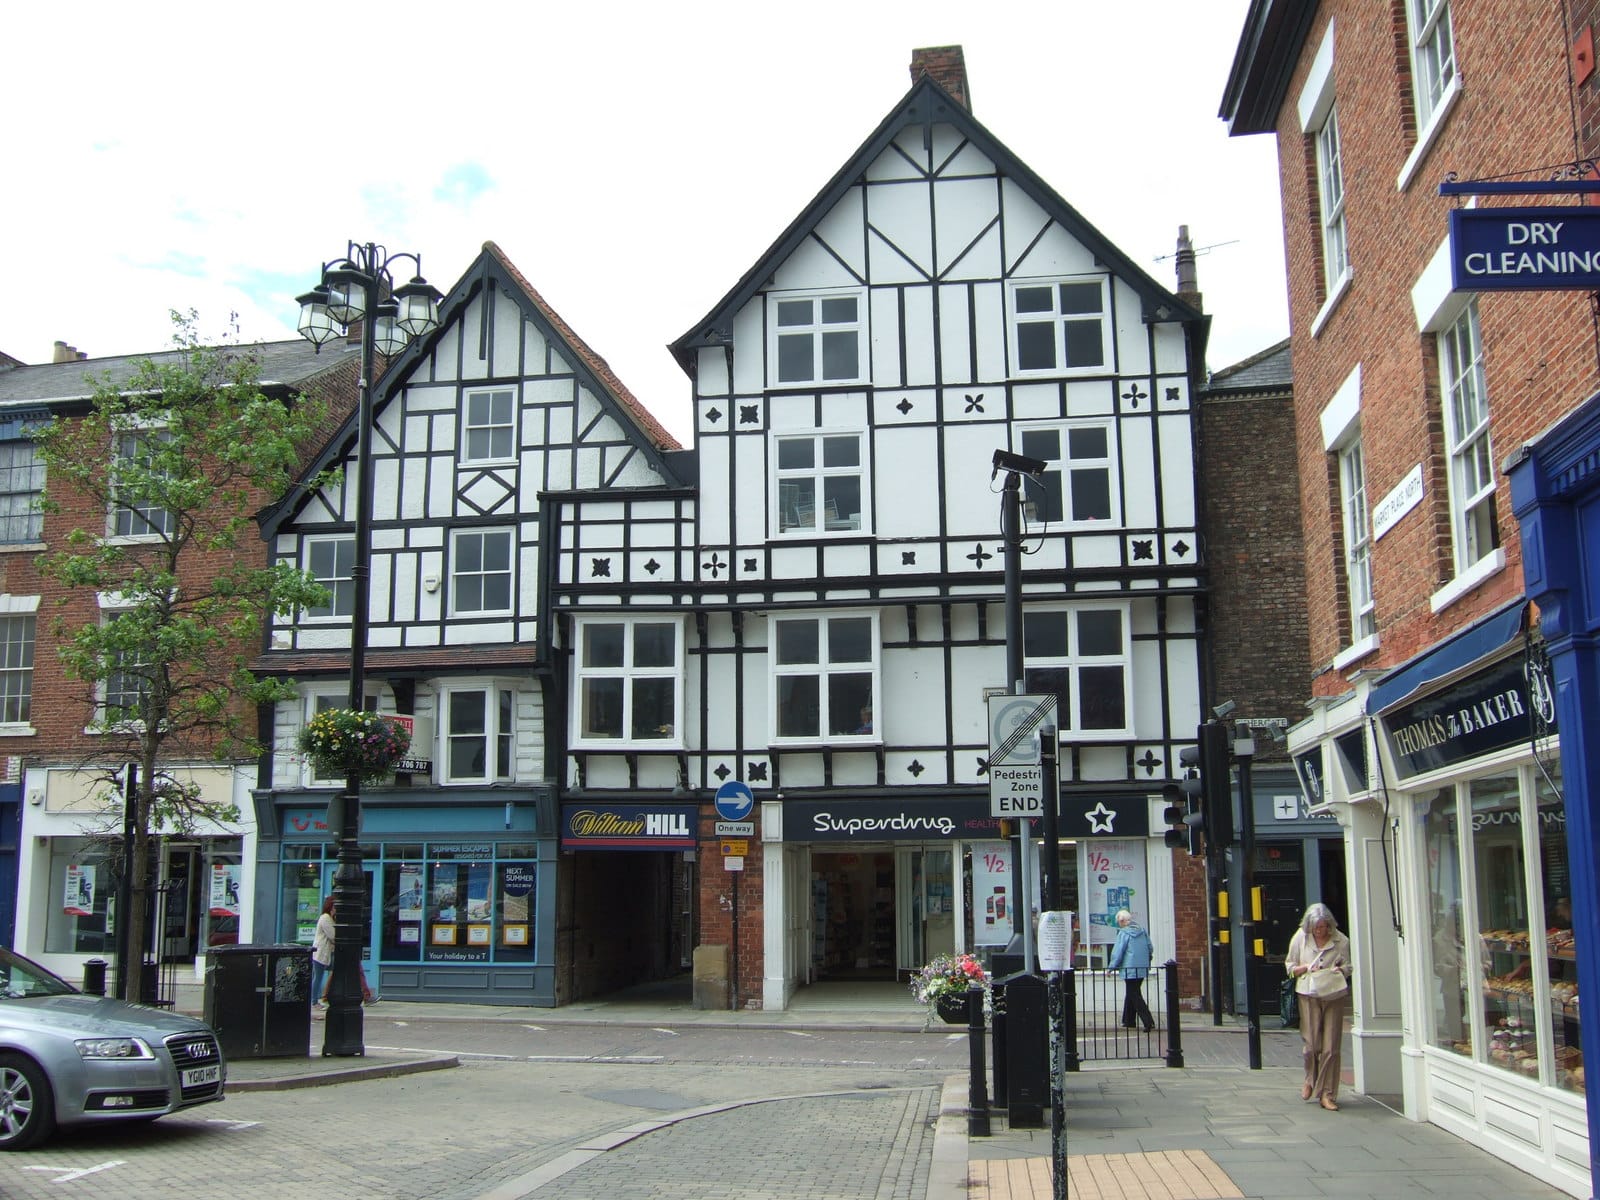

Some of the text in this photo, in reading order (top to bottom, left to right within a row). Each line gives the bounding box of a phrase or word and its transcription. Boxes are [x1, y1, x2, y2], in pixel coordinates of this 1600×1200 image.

[1507, 222, 1564, 245] DRY
[1375, 504, 1390, 528] MARKET
[1406, 475, 1421, 498] NORTH
[1393, 714, 1447, 757] THOMAS
[1446, 715, 1462, 739] The
[1459, 689, 1524, 735] BAKER
[401, 760, 414, 768] 706
[994, 770, 1042, 780] Pedestri
[1011, 782, 1039, 791] Zone
[570, 810, 689, 837] William HILL
[813, 813, 956, 834] Superdrug
[506, 867, 523, 875] NEXT
[1112, 862, 1134, 871] Price
[505, 874, 534, 882] SUMMER
[429, 952, 444, 960] Your
[444, 952, 467, 961] holiday
[481, 952, 487, 960] T
